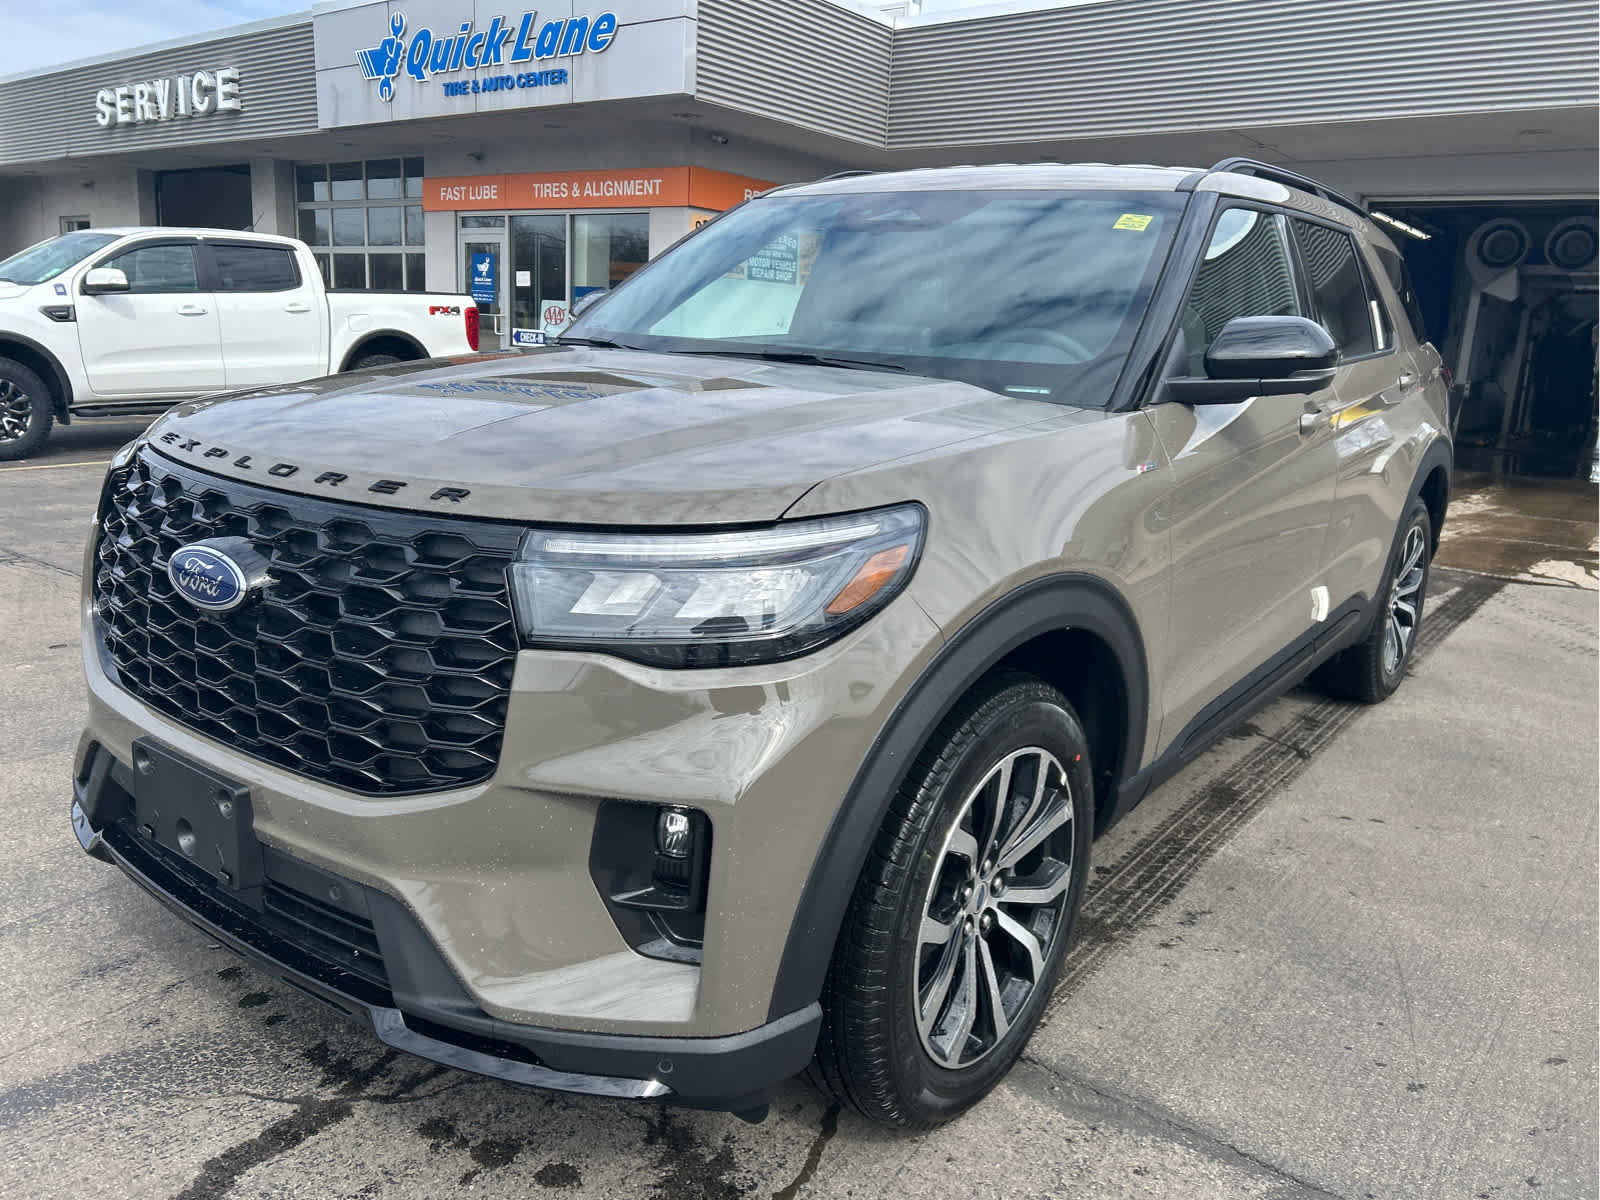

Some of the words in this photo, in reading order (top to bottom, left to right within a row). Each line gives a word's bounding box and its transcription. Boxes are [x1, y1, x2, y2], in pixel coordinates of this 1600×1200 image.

[405, 15, 512, 82] Quick
[509, 9, 619, 64] Lane
[442, 81, 470, 97] TIRE
[471, 79, 481, 95] &
[481, 75, 516, 93] AUTO
[516, 68, 568, 90] CENTER
[95, 66, 241, 128] SERVICE
[440, 186, 467, 201] FAST
[469, 184, 498, 200] LUBE
[533, 182, 569, 198] TIRES
[571, 181, 581, 197] &
[583, 178, 662, 197] ALIGNMENT
[429, 306, 460, 315] FX4
[545, 306, 564, 325] AAA
[520, 332, 543, 343] CHECK-IN
[159, 431, 472, 502] EXPLORER
[179, 557, 223, 597] Ford
